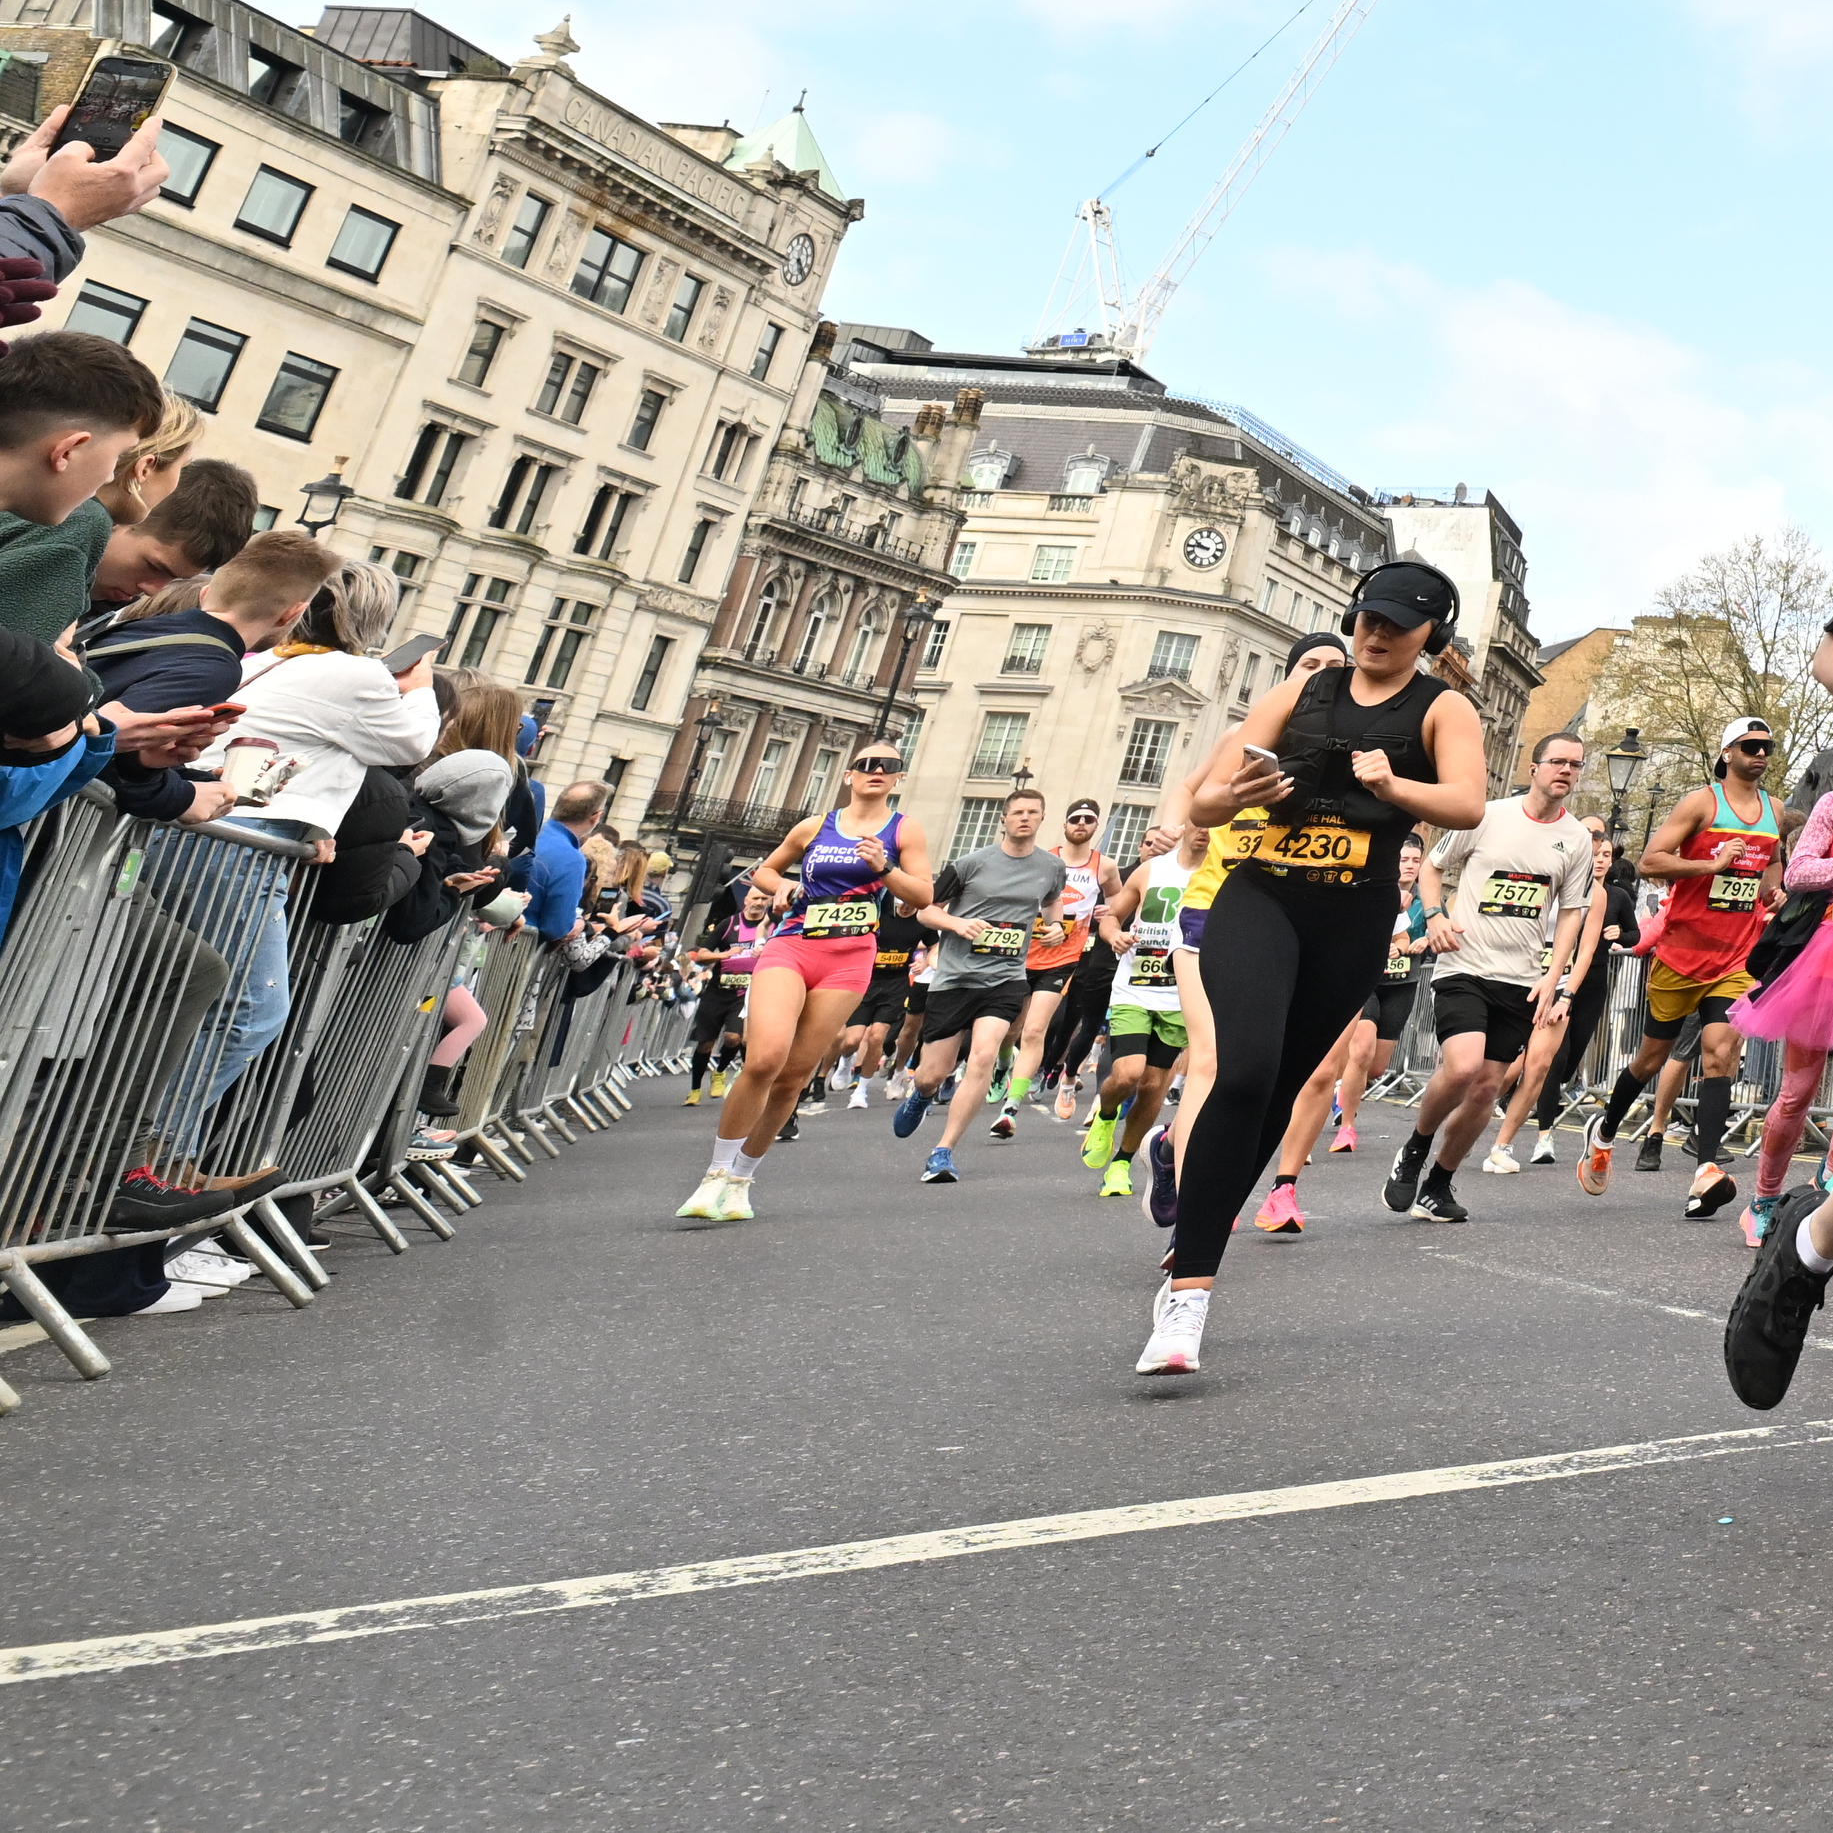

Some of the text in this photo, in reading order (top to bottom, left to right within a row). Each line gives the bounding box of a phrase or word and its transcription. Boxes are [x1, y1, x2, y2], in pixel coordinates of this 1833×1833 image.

[564, 97, 748, 218] CANADIAN PACIFIC
[1273, 832, 1352, 861] 4230
[808, 854, 861, 865] Cancer
[1507, 873, 1534, 881] MARTYN
[1493, 883, 1539, 903] 7577
[1721, 880, 1756, 898] 7975
[817, 906, 868, 923] 7425
[983, 930, 1020, 945] 7792
[1137, 926, 1169, 936] British
[1139, 937, 1170, 947] ounda
[880, 954, 904, 963] 5498
[723, 976, 748, 984] 8062
